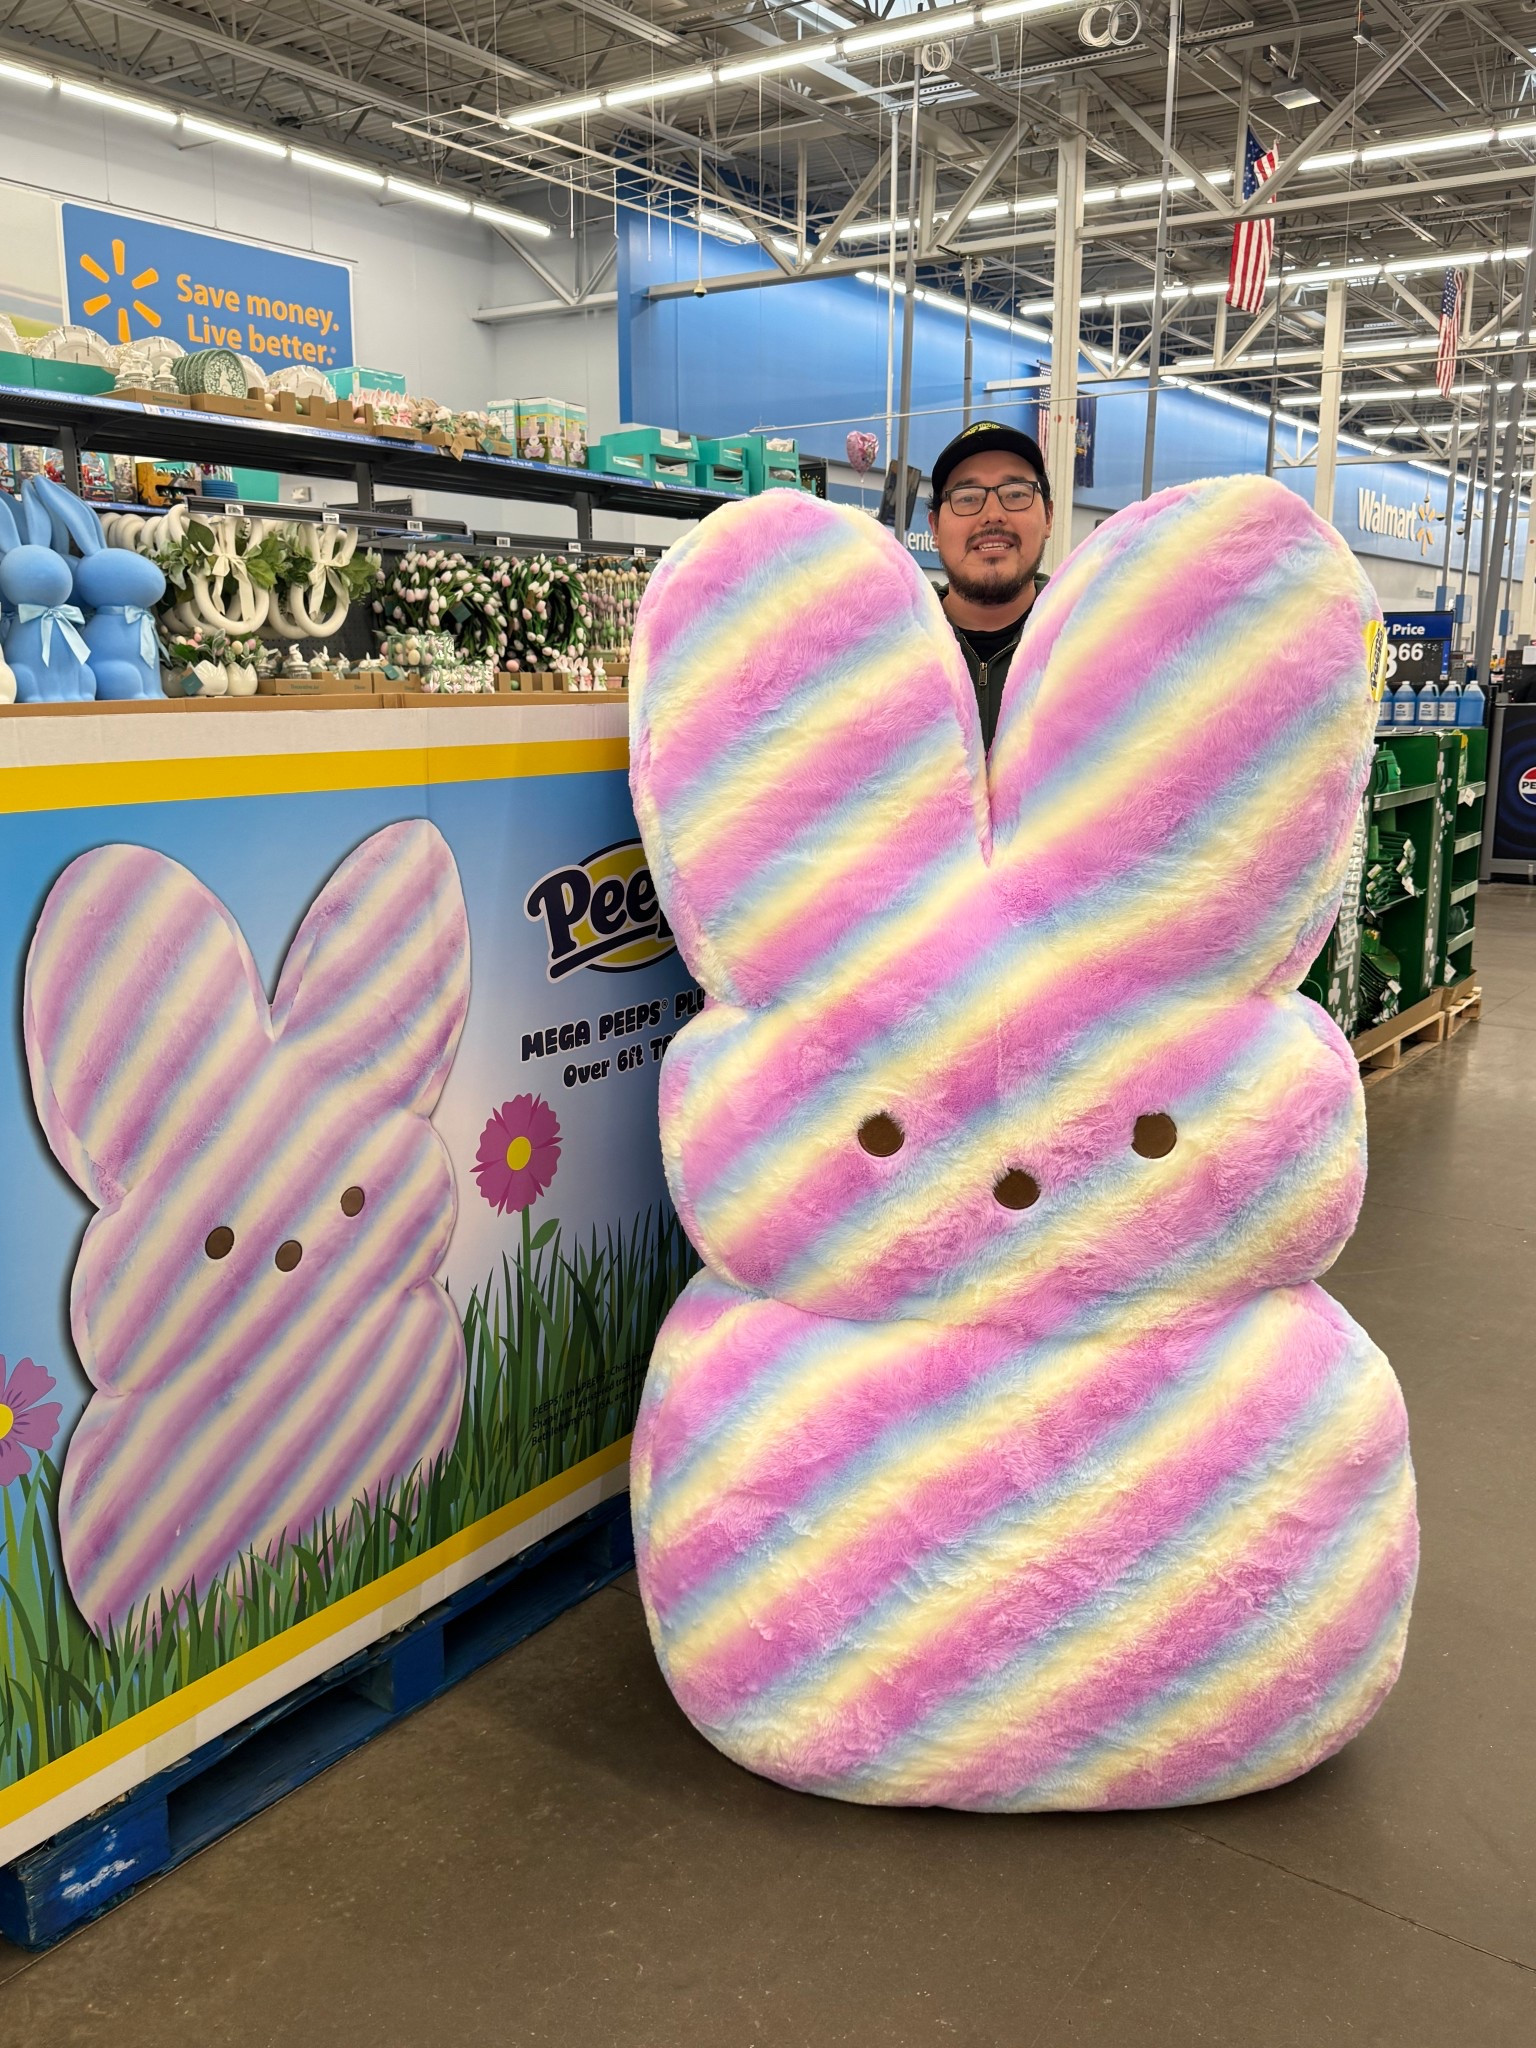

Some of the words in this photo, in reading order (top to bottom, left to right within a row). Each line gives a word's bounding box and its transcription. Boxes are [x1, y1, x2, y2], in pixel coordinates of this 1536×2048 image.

[176, 274, 240, 312] Save
[247, 294, 339, 336] money.
[187, 313, 242, 350] Live
[905, 530, 939, 552] ente
[1358, 487, 1417, 541] Walmart
[1392, 623, 1426, 636] Price
[527, 868, 674, 962] Pee
[521, 1020, 591, 1062] MEGA
[598, 999, 668, 1041] PEEPS®
[563, 1059, 610, 1088] Over
[617, 1043, 644, 1072] 6ft
[650, 1033, 677, 1061] TA
